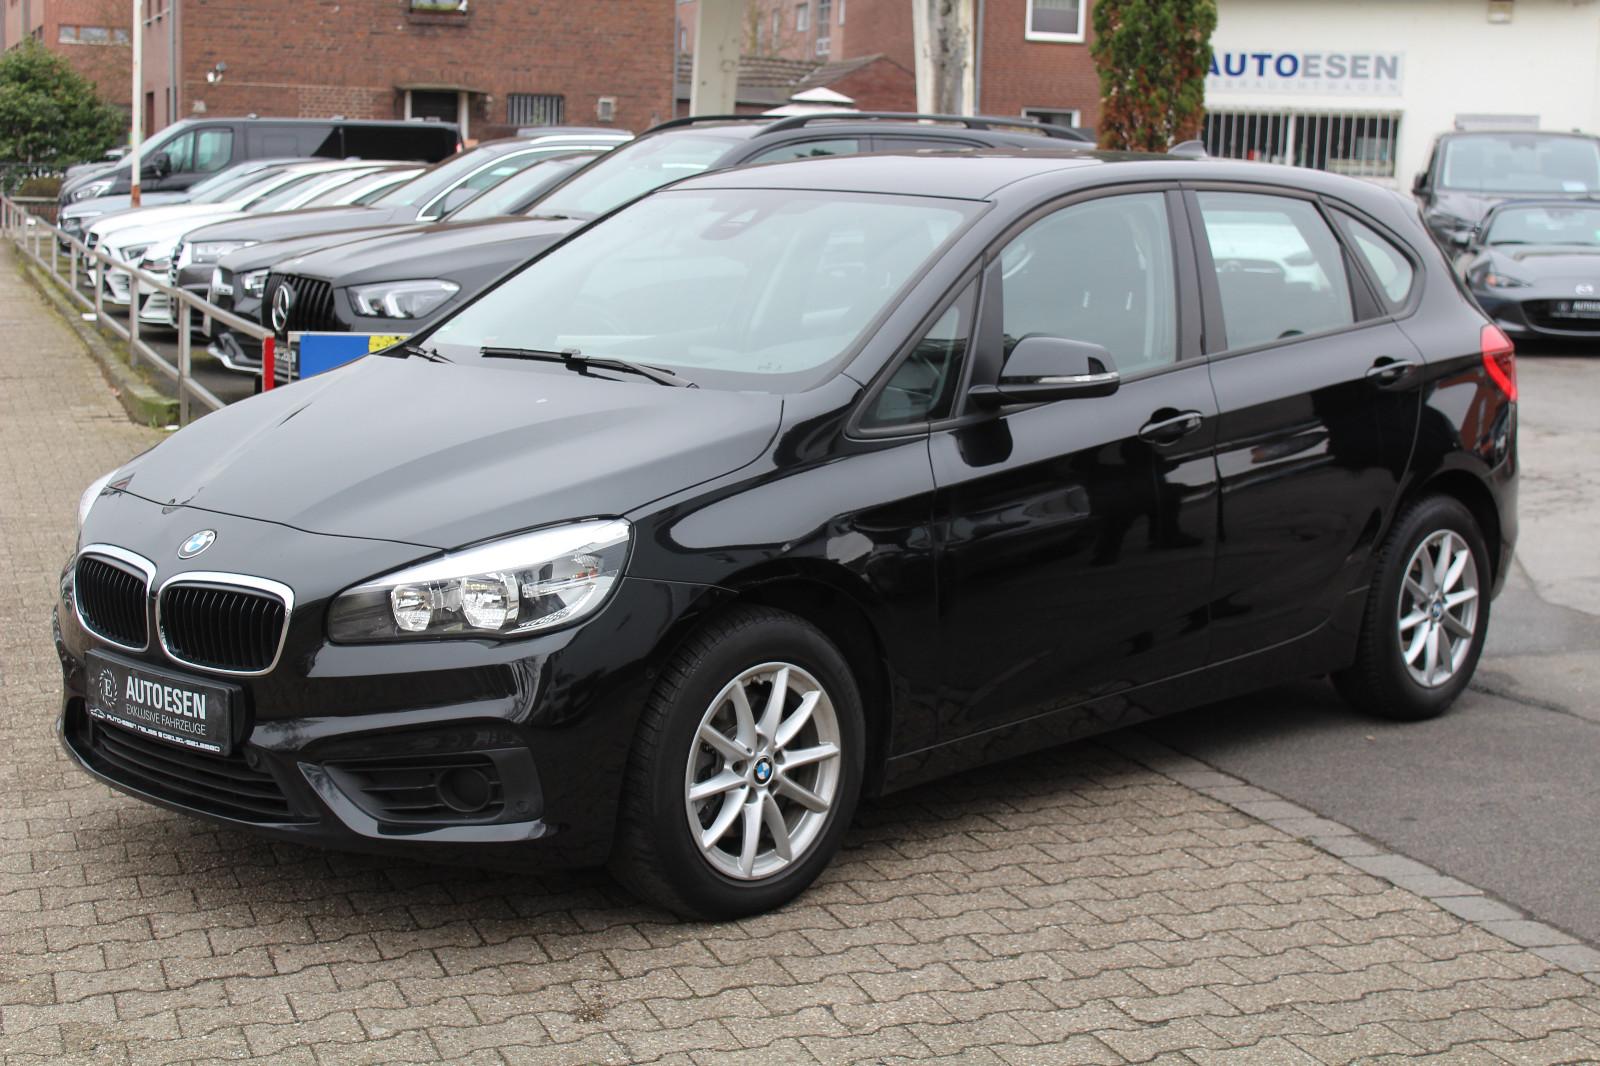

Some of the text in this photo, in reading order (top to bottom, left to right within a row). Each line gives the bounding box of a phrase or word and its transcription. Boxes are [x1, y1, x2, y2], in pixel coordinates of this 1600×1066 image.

[126, 676, 206, 719] AUTOESEN
[126, 703, 206, 735] EXKLUSIVE FAHRZEUGE
